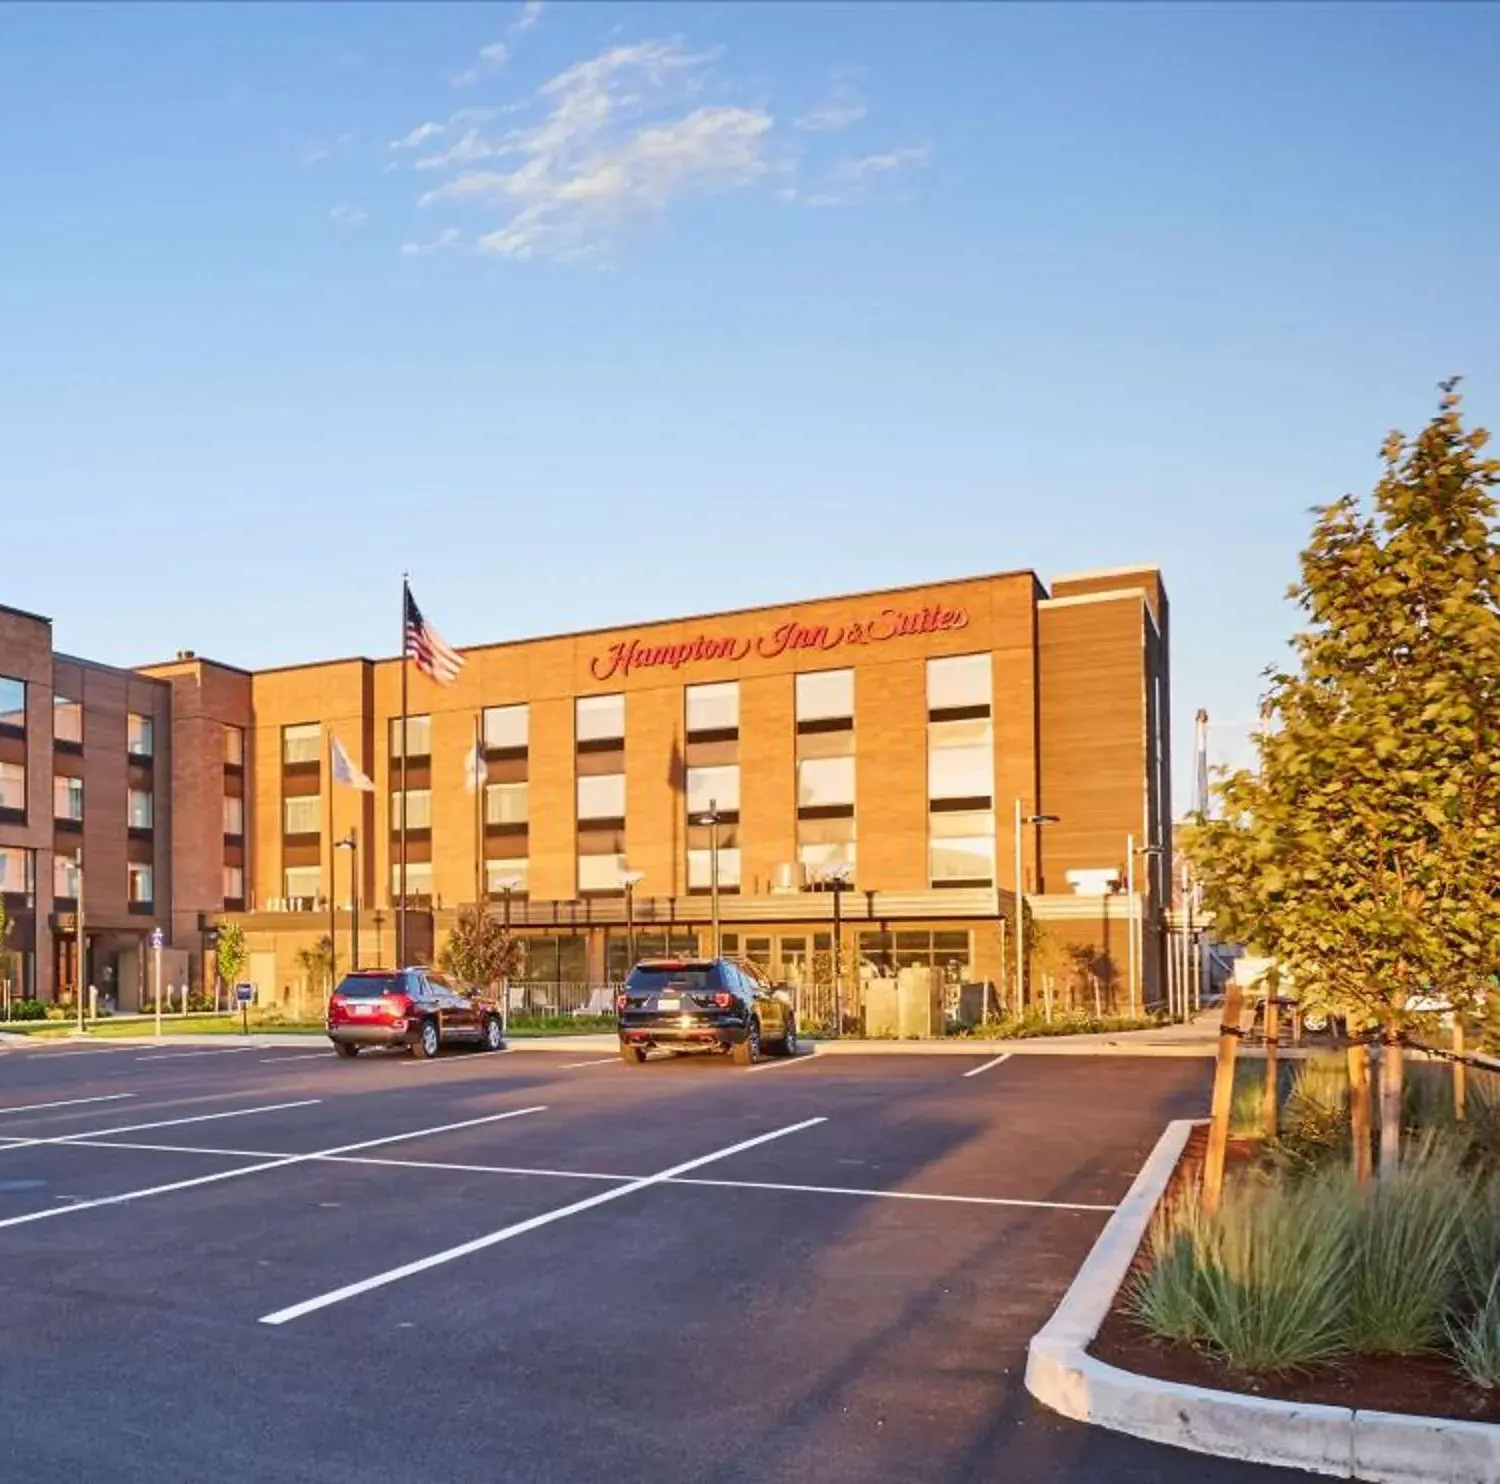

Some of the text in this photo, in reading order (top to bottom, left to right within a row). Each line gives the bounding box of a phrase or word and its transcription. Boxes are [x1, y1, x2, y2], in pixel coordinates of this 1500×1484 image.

[591, 604, 969, 681] Hampton Inn & Suites
